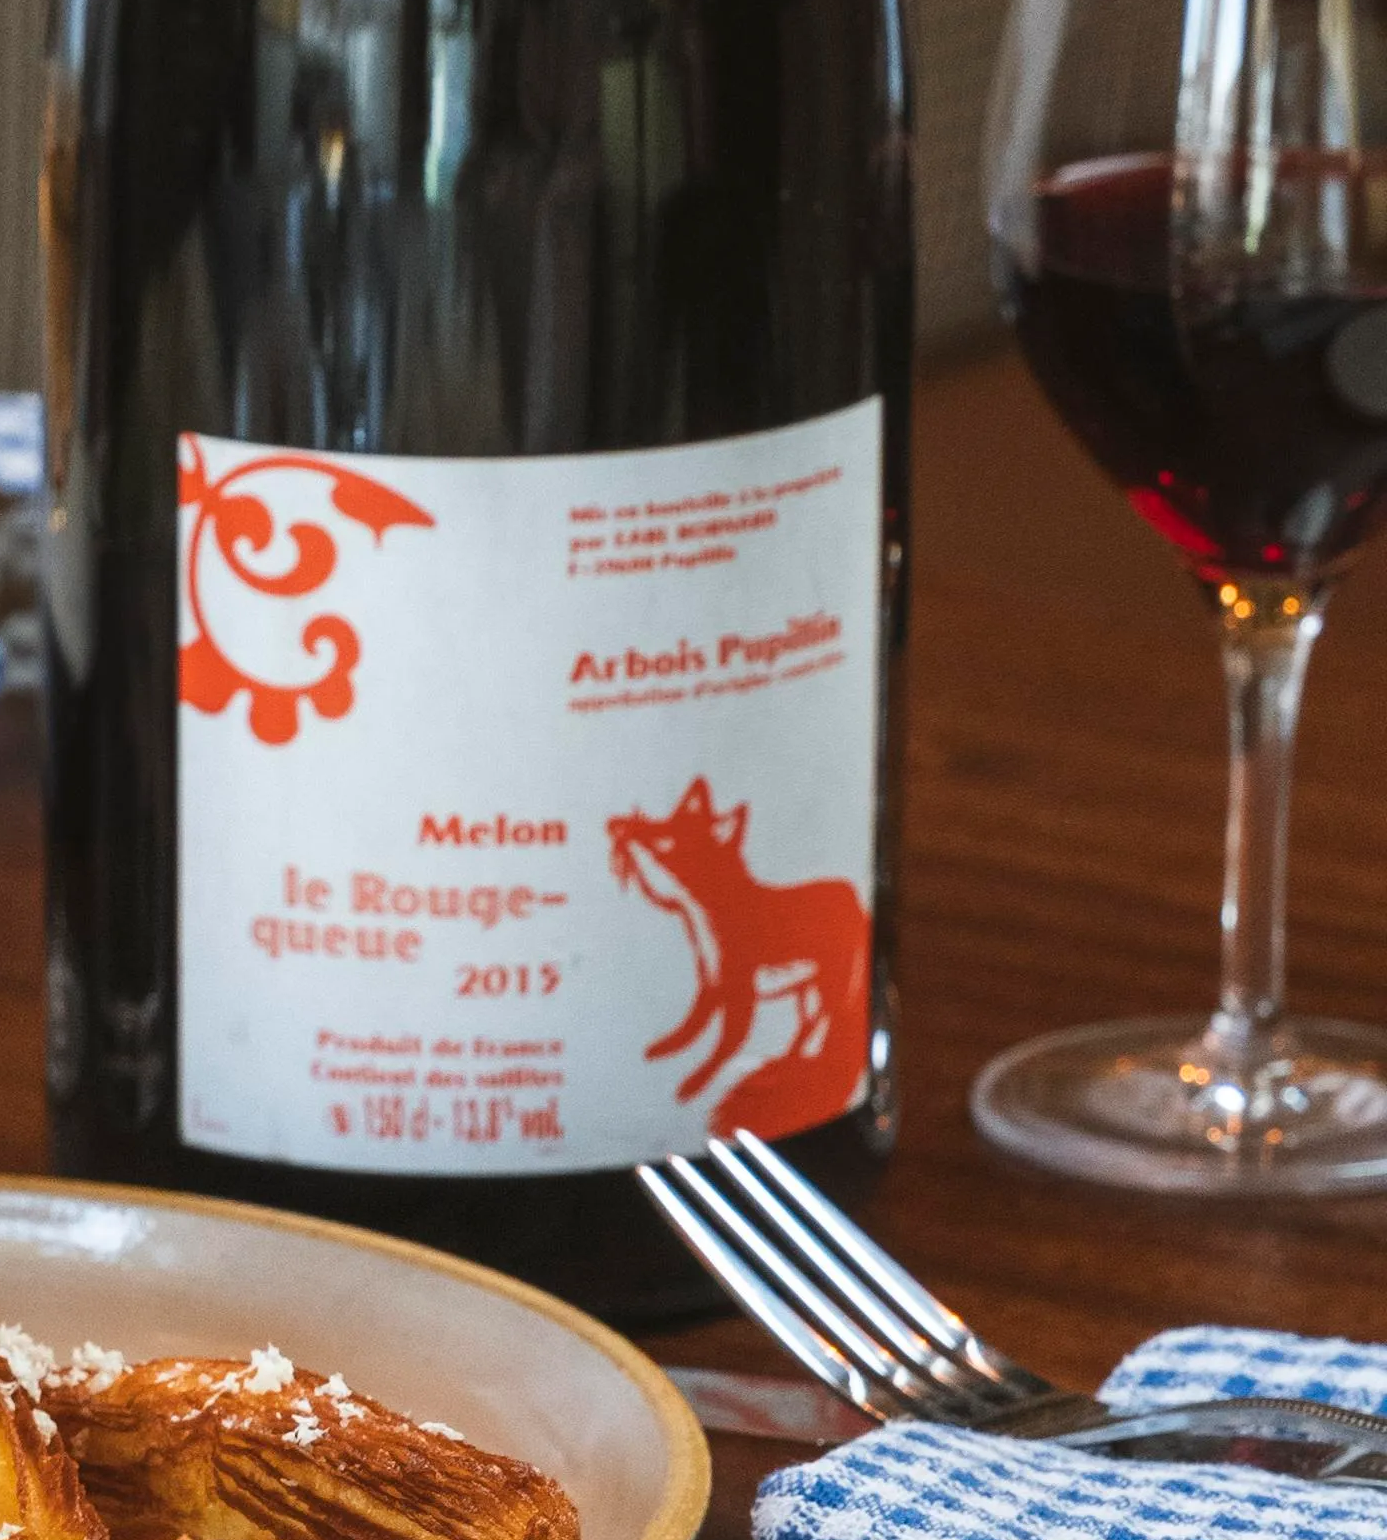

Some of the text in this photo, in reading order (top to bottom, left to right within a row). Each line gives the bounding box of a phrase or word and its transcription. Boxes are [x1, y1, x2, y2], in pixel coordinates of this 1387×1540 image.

[569, 637, 705, 685] Arbois
[417, 811, 568, 848] Melon
[282, 863, 568, 930] le Rouge-
[250, 913, 423, 962] queue
[457, 962, 561, 998] 2015
